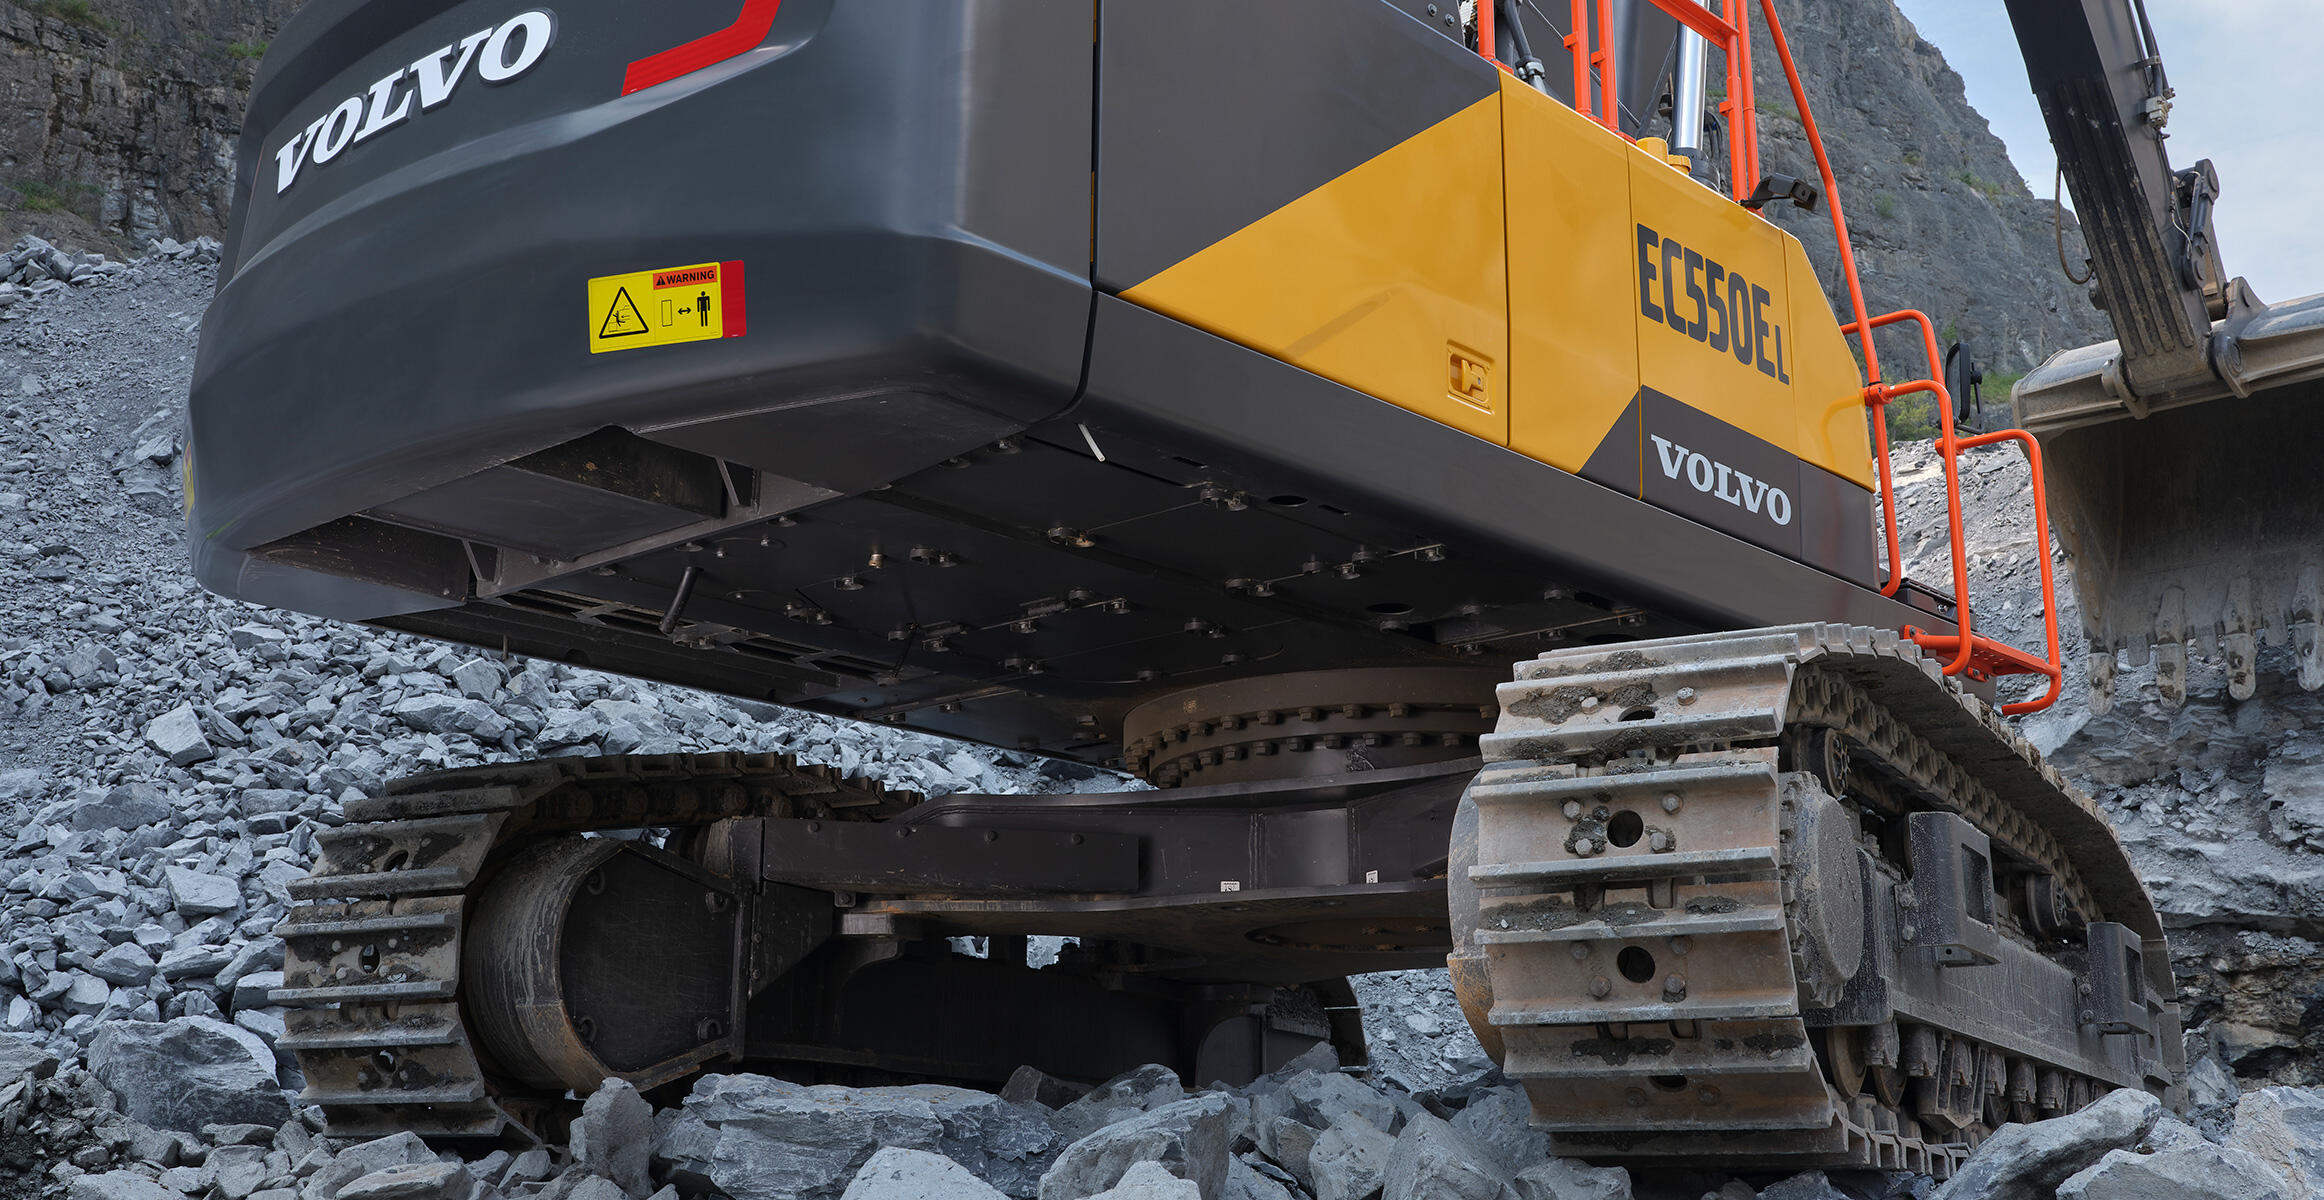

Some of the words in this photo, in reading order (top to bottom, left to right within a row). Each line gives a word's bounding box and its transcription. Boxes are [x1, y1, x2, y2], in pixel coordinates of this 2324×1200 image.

[275, 11, 551, 194] VOLVO
[666, 270, 715, 284] WARNING
[1651, 434, 1792, 526] VOLVO
